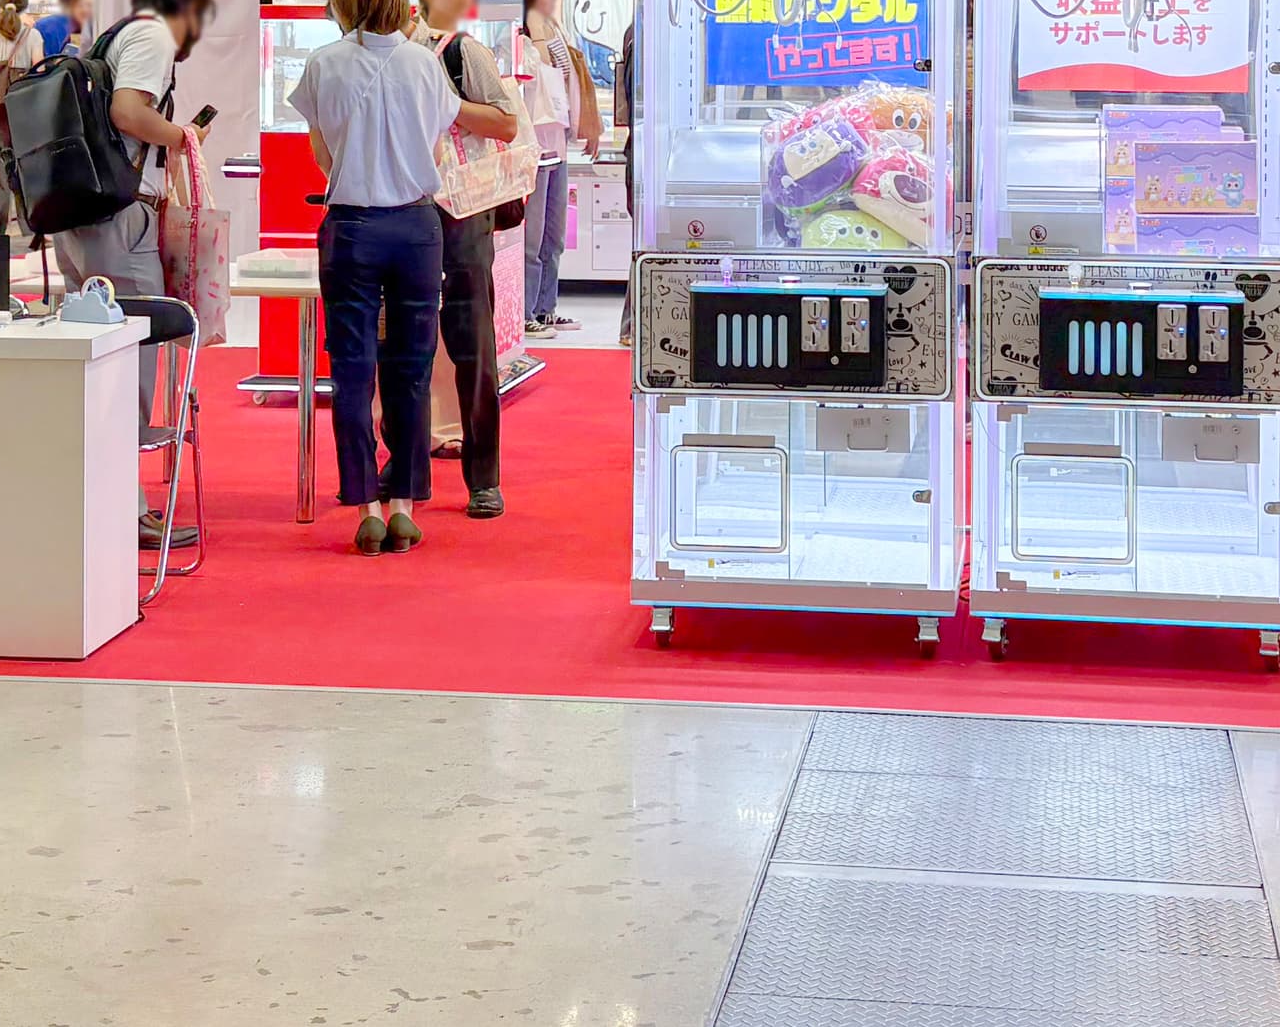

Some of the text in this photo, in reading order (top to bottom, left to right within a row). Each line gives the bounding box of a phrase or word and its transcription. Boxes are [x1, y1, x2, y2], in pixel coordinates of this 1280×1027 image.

[739, 259, 781, 271] PLEASE
[1083, 266, 1127, 278] PLEASE
[671, 307, 688, 321] GA
[1013, 313, 1040, 326] GAM
[888, 358, 904, 367] LOVE
